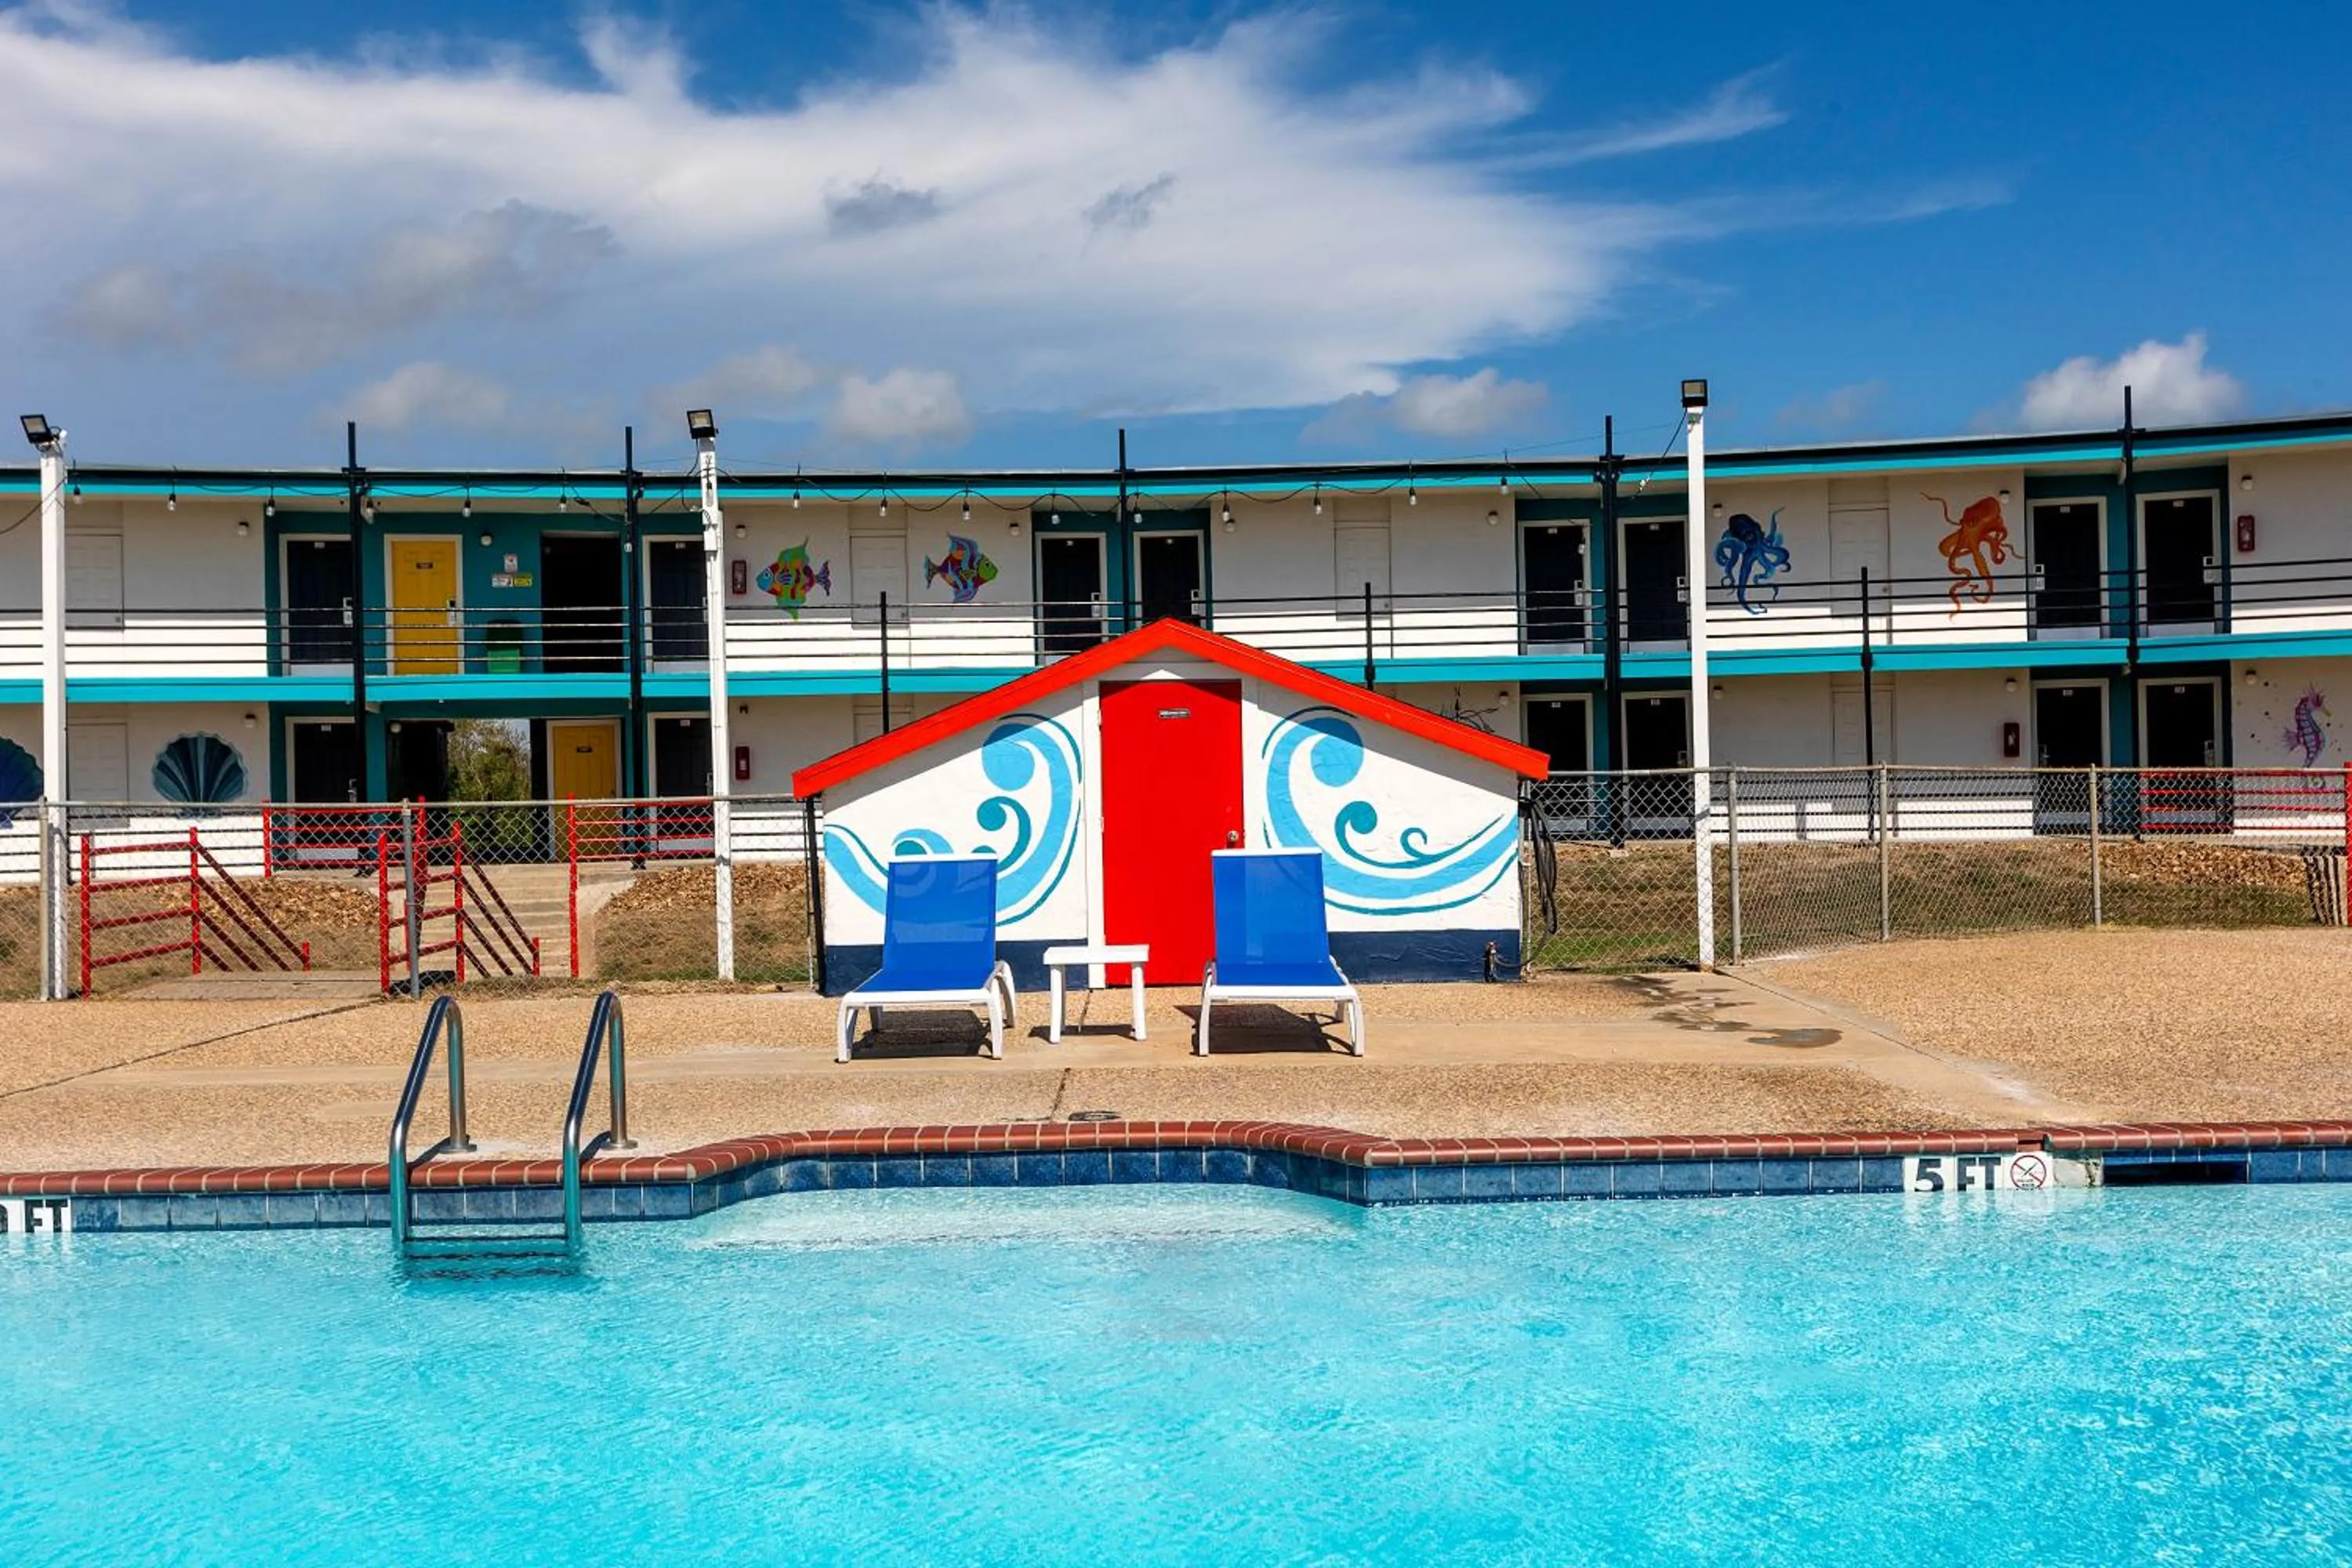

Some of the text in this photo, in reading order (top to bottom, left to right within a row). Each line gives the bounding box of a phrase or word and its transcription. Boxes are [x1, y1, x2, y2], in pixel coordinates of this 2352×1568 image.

[1914, 1157, 2002, 1192] 5 FT
[24, 1200, 68, 1232] FT
